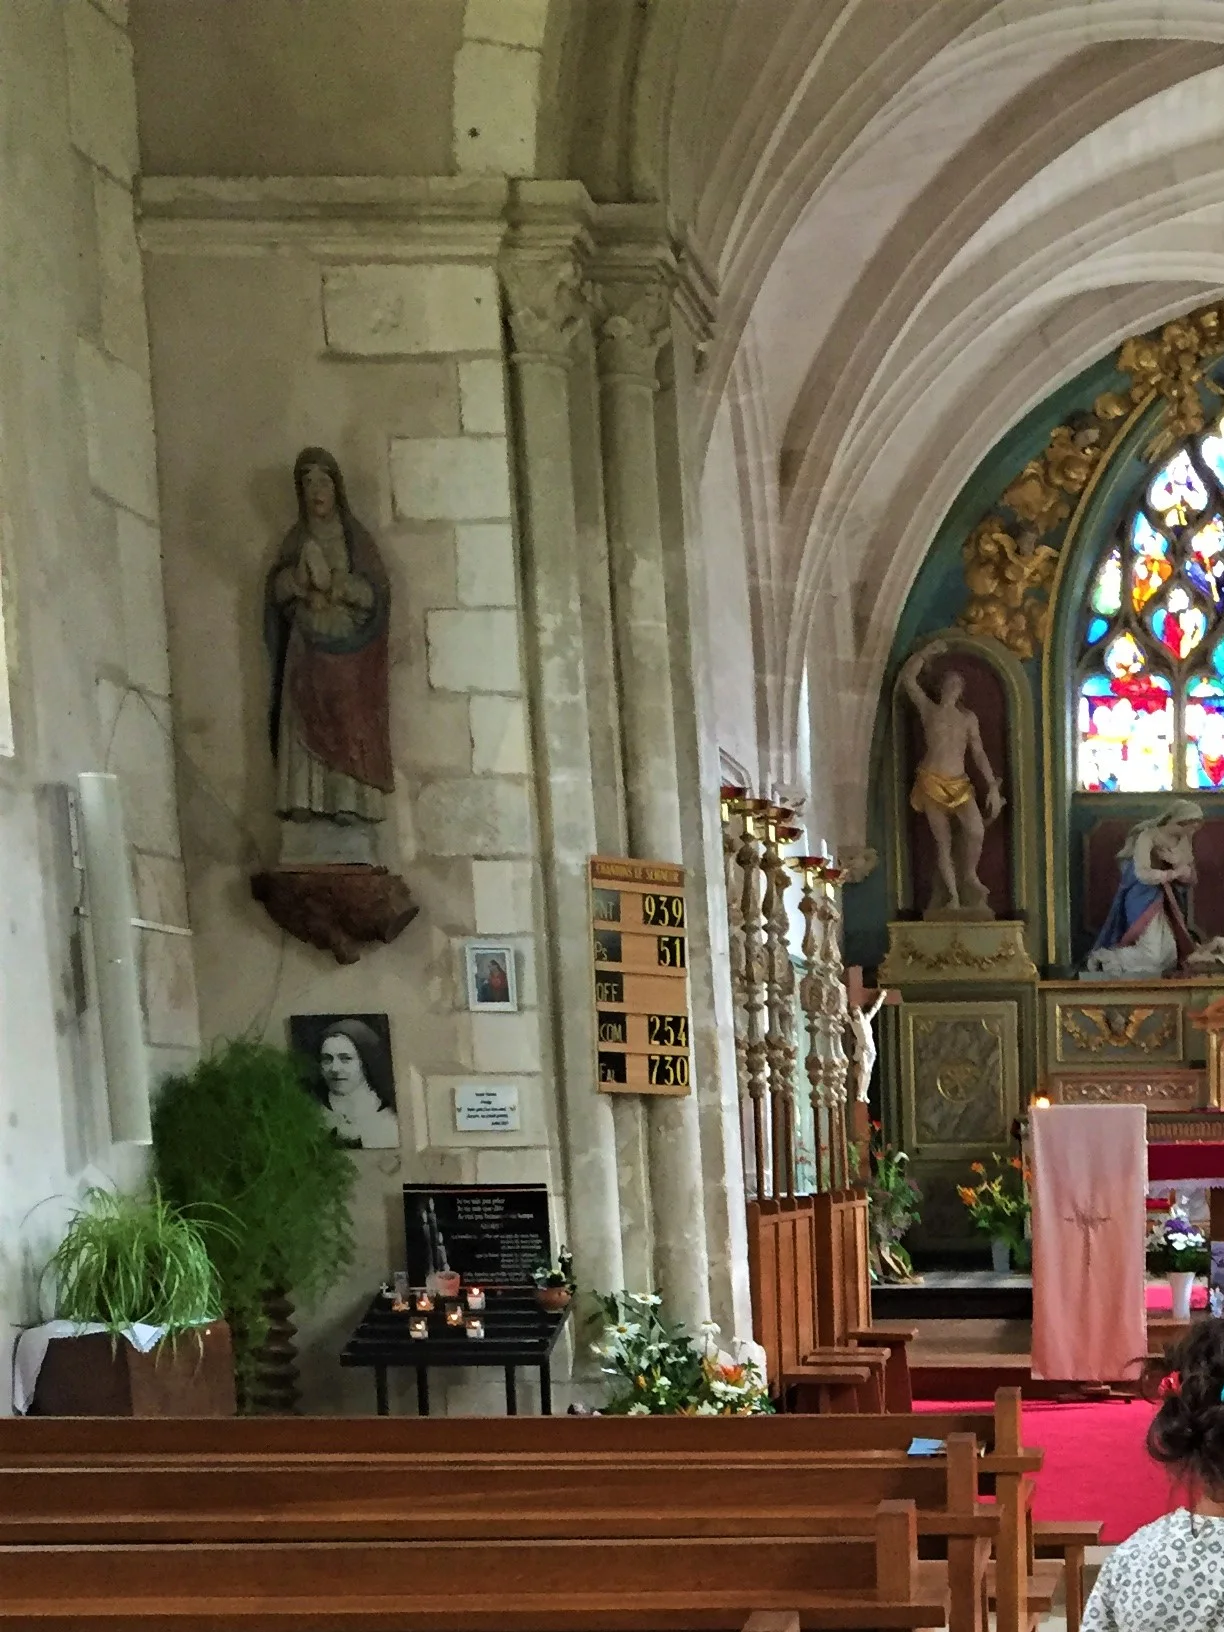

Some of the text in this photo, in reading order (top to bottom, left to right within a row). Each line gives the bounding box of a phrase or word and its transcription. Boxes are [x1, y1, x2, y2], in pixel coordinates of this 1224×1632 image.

[645, 894, 683, 927] 939
[660, 937, 681, 968] 51
[597, 982, 619, 1002] OFF
[600, 1016, 687, 1047] COM 254
[650, 1055, 688, 1086] 730
